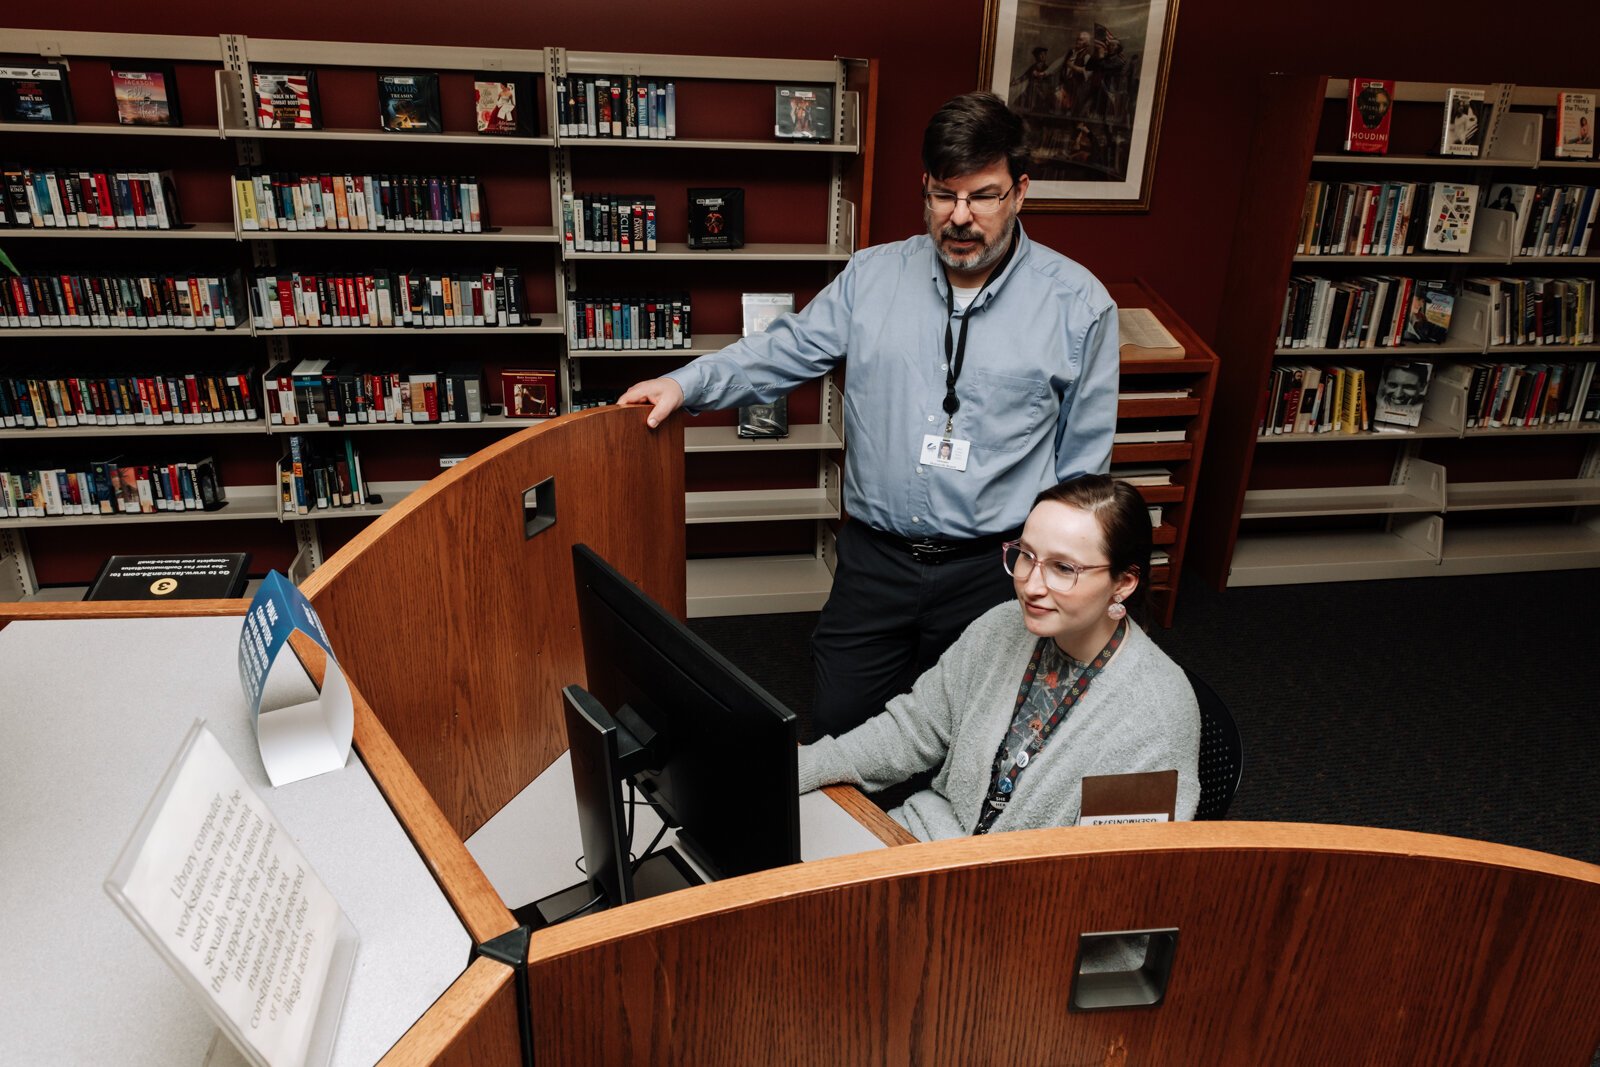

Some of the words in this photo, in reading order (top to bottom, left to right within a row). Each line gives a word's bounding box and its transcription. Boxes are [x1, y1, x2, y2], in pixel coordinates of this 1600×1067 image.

[384, 84, 418, 93] WOODS
[1352, 132, 1388, 141] HOUDINI
[157, 582, 170, 591] 3
[256, 606, 274, 647] COMPUTERS
[265, 598, 279, 626] PUBLIC
[170, 854, 197, 899] Library
[194, 792, 222, 852] computer
[228, 803, 252, 852] transmit
[175, 854, 214, 938] workstations
[210, 829, 225, 857] may
[222, 804, 236, 828] not
[229, 789, 241, 807] be
[224, 850, 233, 868] or
[256, 822, 277, 875] prurient
[204, 912, 229, 969] sexually
[225, 863, 246, 911] explicit
[242, 813, 263, 865] material
[211, 866, 228, 899] view
[242, 891, 253, 908] to
[247, 869, 260, 893] the
[202, 899, 216, 917] to
[233, 928, 256, 983] interest
[252, 911, 261, 929] or
[257, 887, 269, 914] any
[265, 854, 280, 888] other
[190, 912, 209, 952] used
[224, 909, 247, 962] appeals
[247, 930, 270, 993] material
[264, 905, 279, 934] that
[274, 895, 281, 908] is
[278, 871, 291, 895] not
[249, 927, 286, 1030] constitutionally
[282, 863, 305, 930] protected
[211, 959, 229, 994] that
[269, 1002, 277, 1021] or
[273, 985, 283, 1003] to
[280, 930, 300, 985] conduct
[295, 896, 310, 930] other
[284, 971, 302, 1017] illegal
